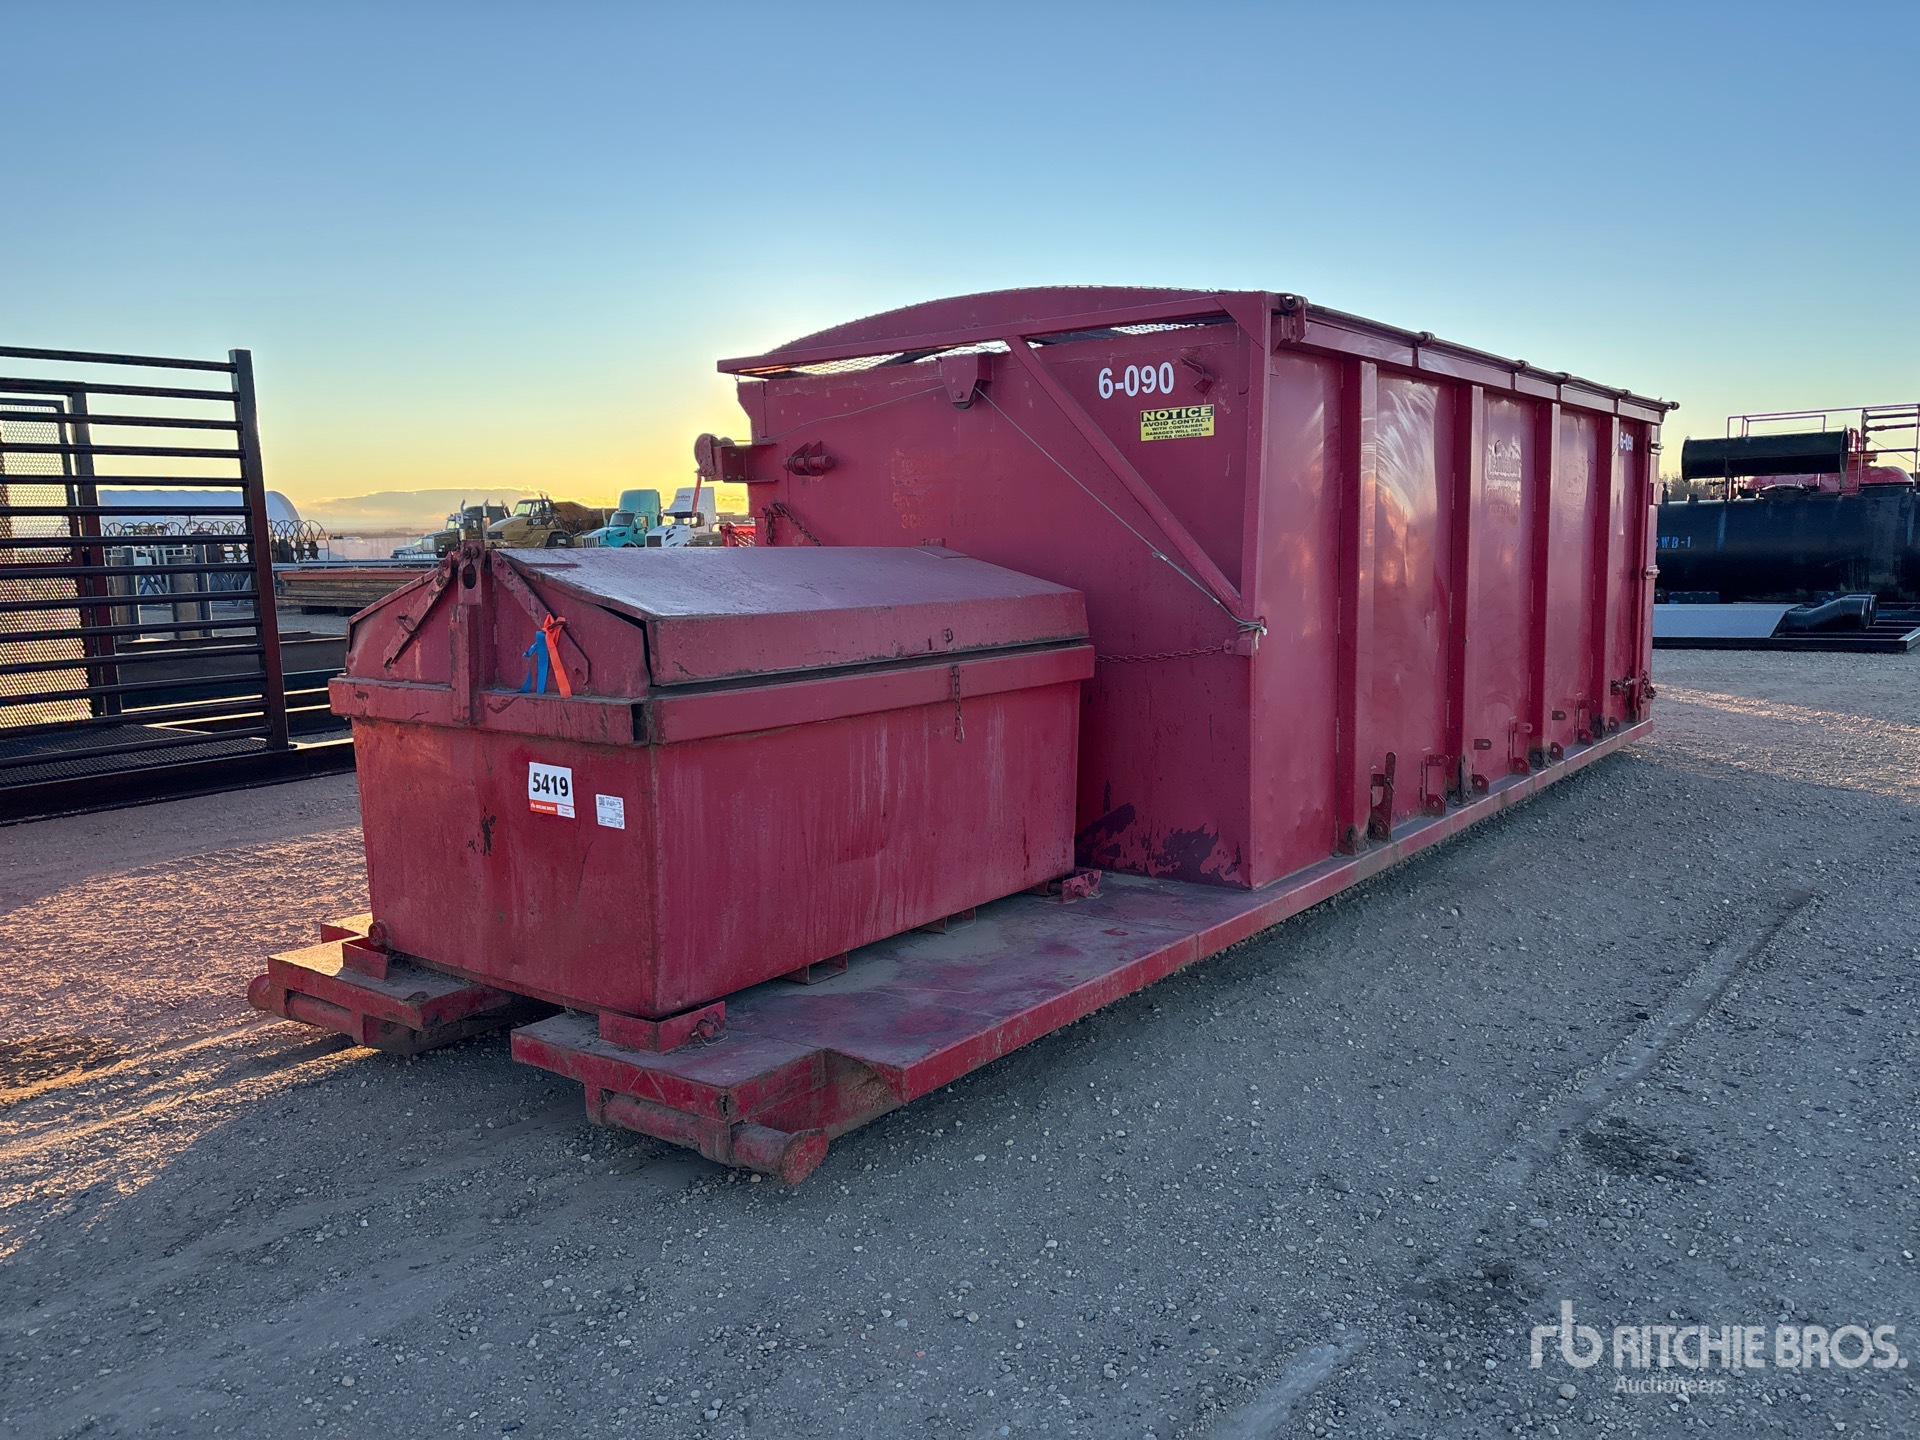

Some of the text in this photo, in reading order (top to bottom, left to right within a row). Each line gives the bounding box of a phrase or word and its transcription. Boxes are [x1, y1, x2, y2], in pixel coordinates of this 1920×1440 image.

[1098, 362, 1175, 399] 6-090
[1142, 406, 1212, 422] NOTICE
[1143, 417, 1212, 428] AVOID CONTACT
[532, 771, 569, 797] 5419
